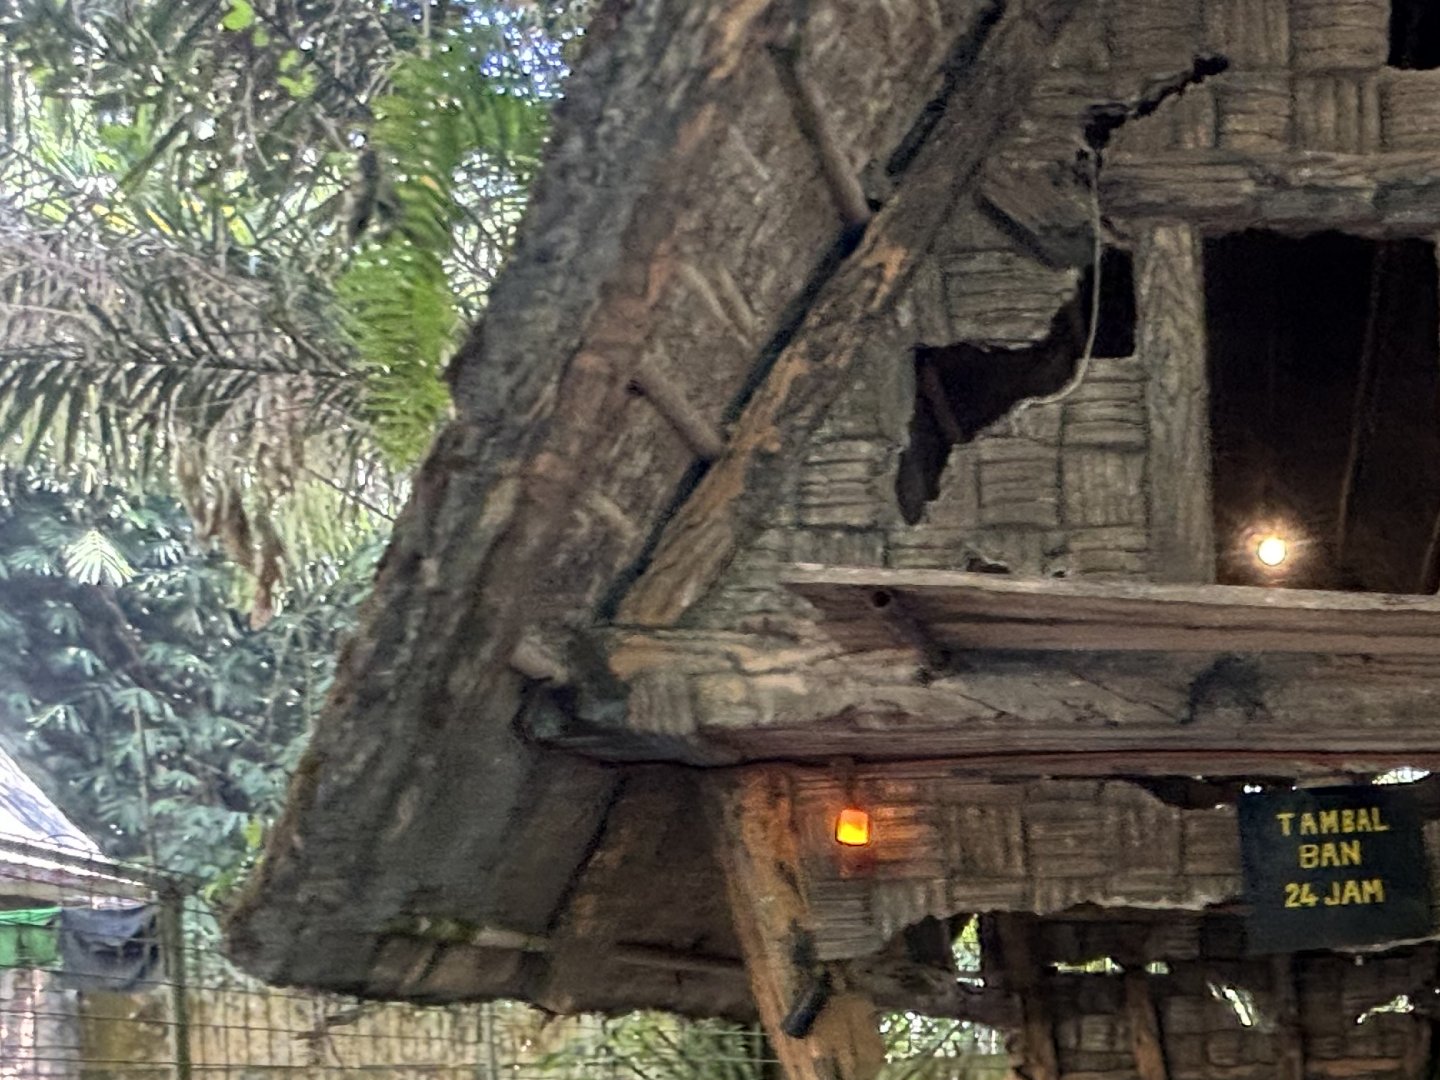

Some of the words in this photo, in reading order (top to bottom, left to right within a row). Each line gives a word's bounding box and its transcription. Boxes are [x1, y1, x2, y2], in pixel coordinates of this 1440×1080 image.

[1275, 807, 1390, 837] TAMBAL
[1299, 839, 1361, 869] BAN
[1284, 882, 1319, 908] 24
[1323, 878, 1385, 906] JAM
